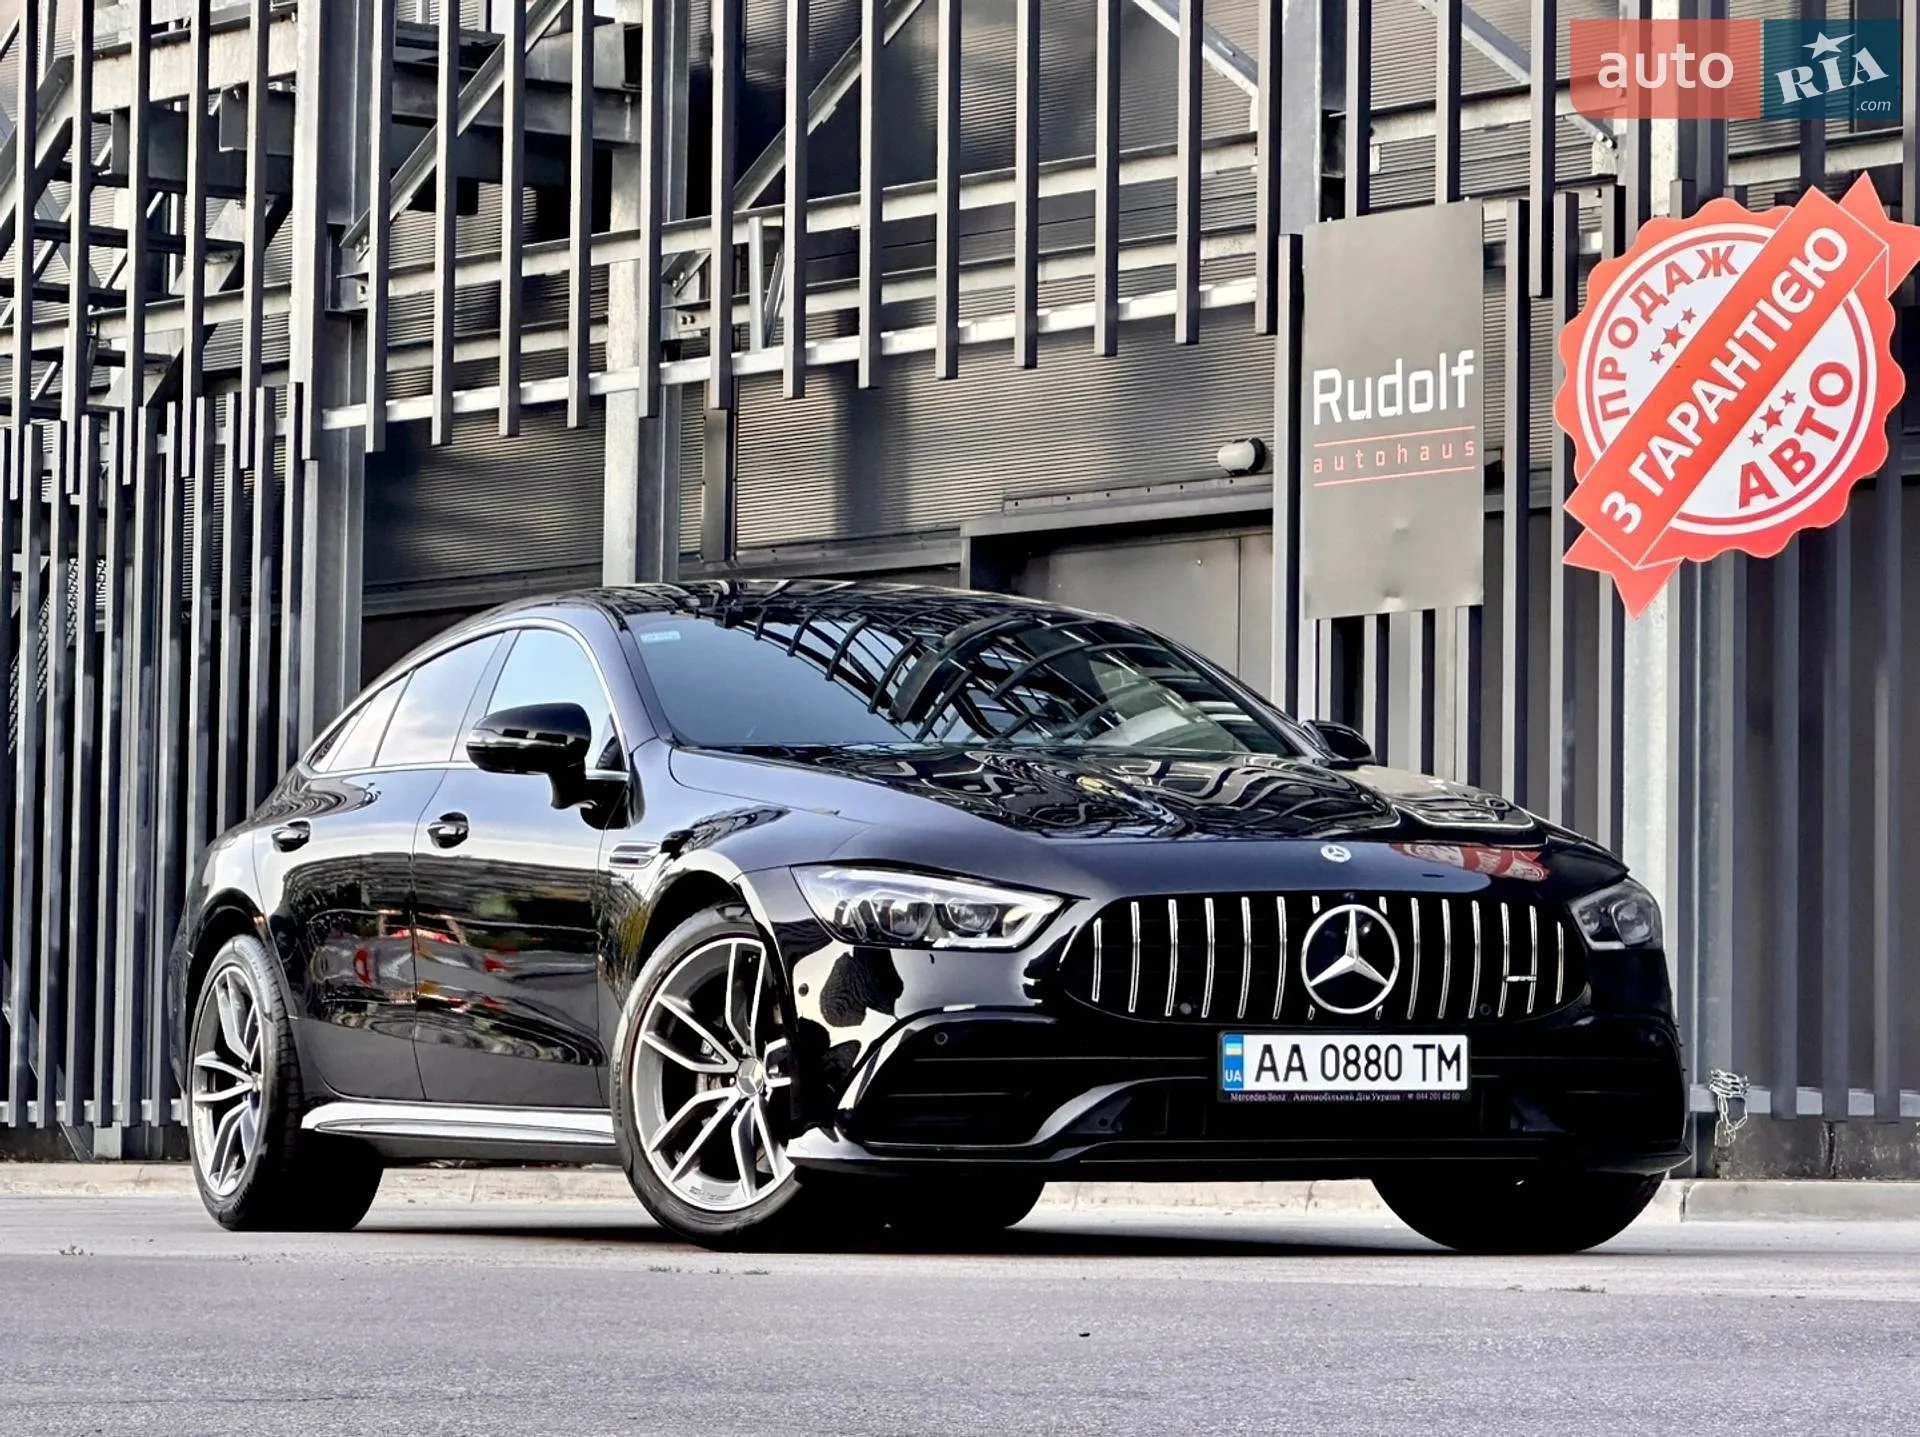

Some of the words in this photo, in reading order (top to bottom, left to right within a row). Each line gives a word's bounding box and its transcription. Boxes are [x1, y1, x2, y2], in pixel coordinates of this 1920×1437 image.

[1597, 244, 1740, 422] ПРОДАЖ
[1313, 349, 1475, 426] Rudolf
[1600, 490, 1643, 535] З
[1628, 226, 1849, 497] ГАРАНТІЄЮ
[1313, 440, 1475, 473] autohaus
[1738, 361, 1853, 510] АВТО
[1224, 1070, 1242, 1082] UA
[1254, 1043, 1308, 1083] AA
[1320, 1043, 1402, 1082] 0880
[1412, 1043, 1461, 1083] TM
